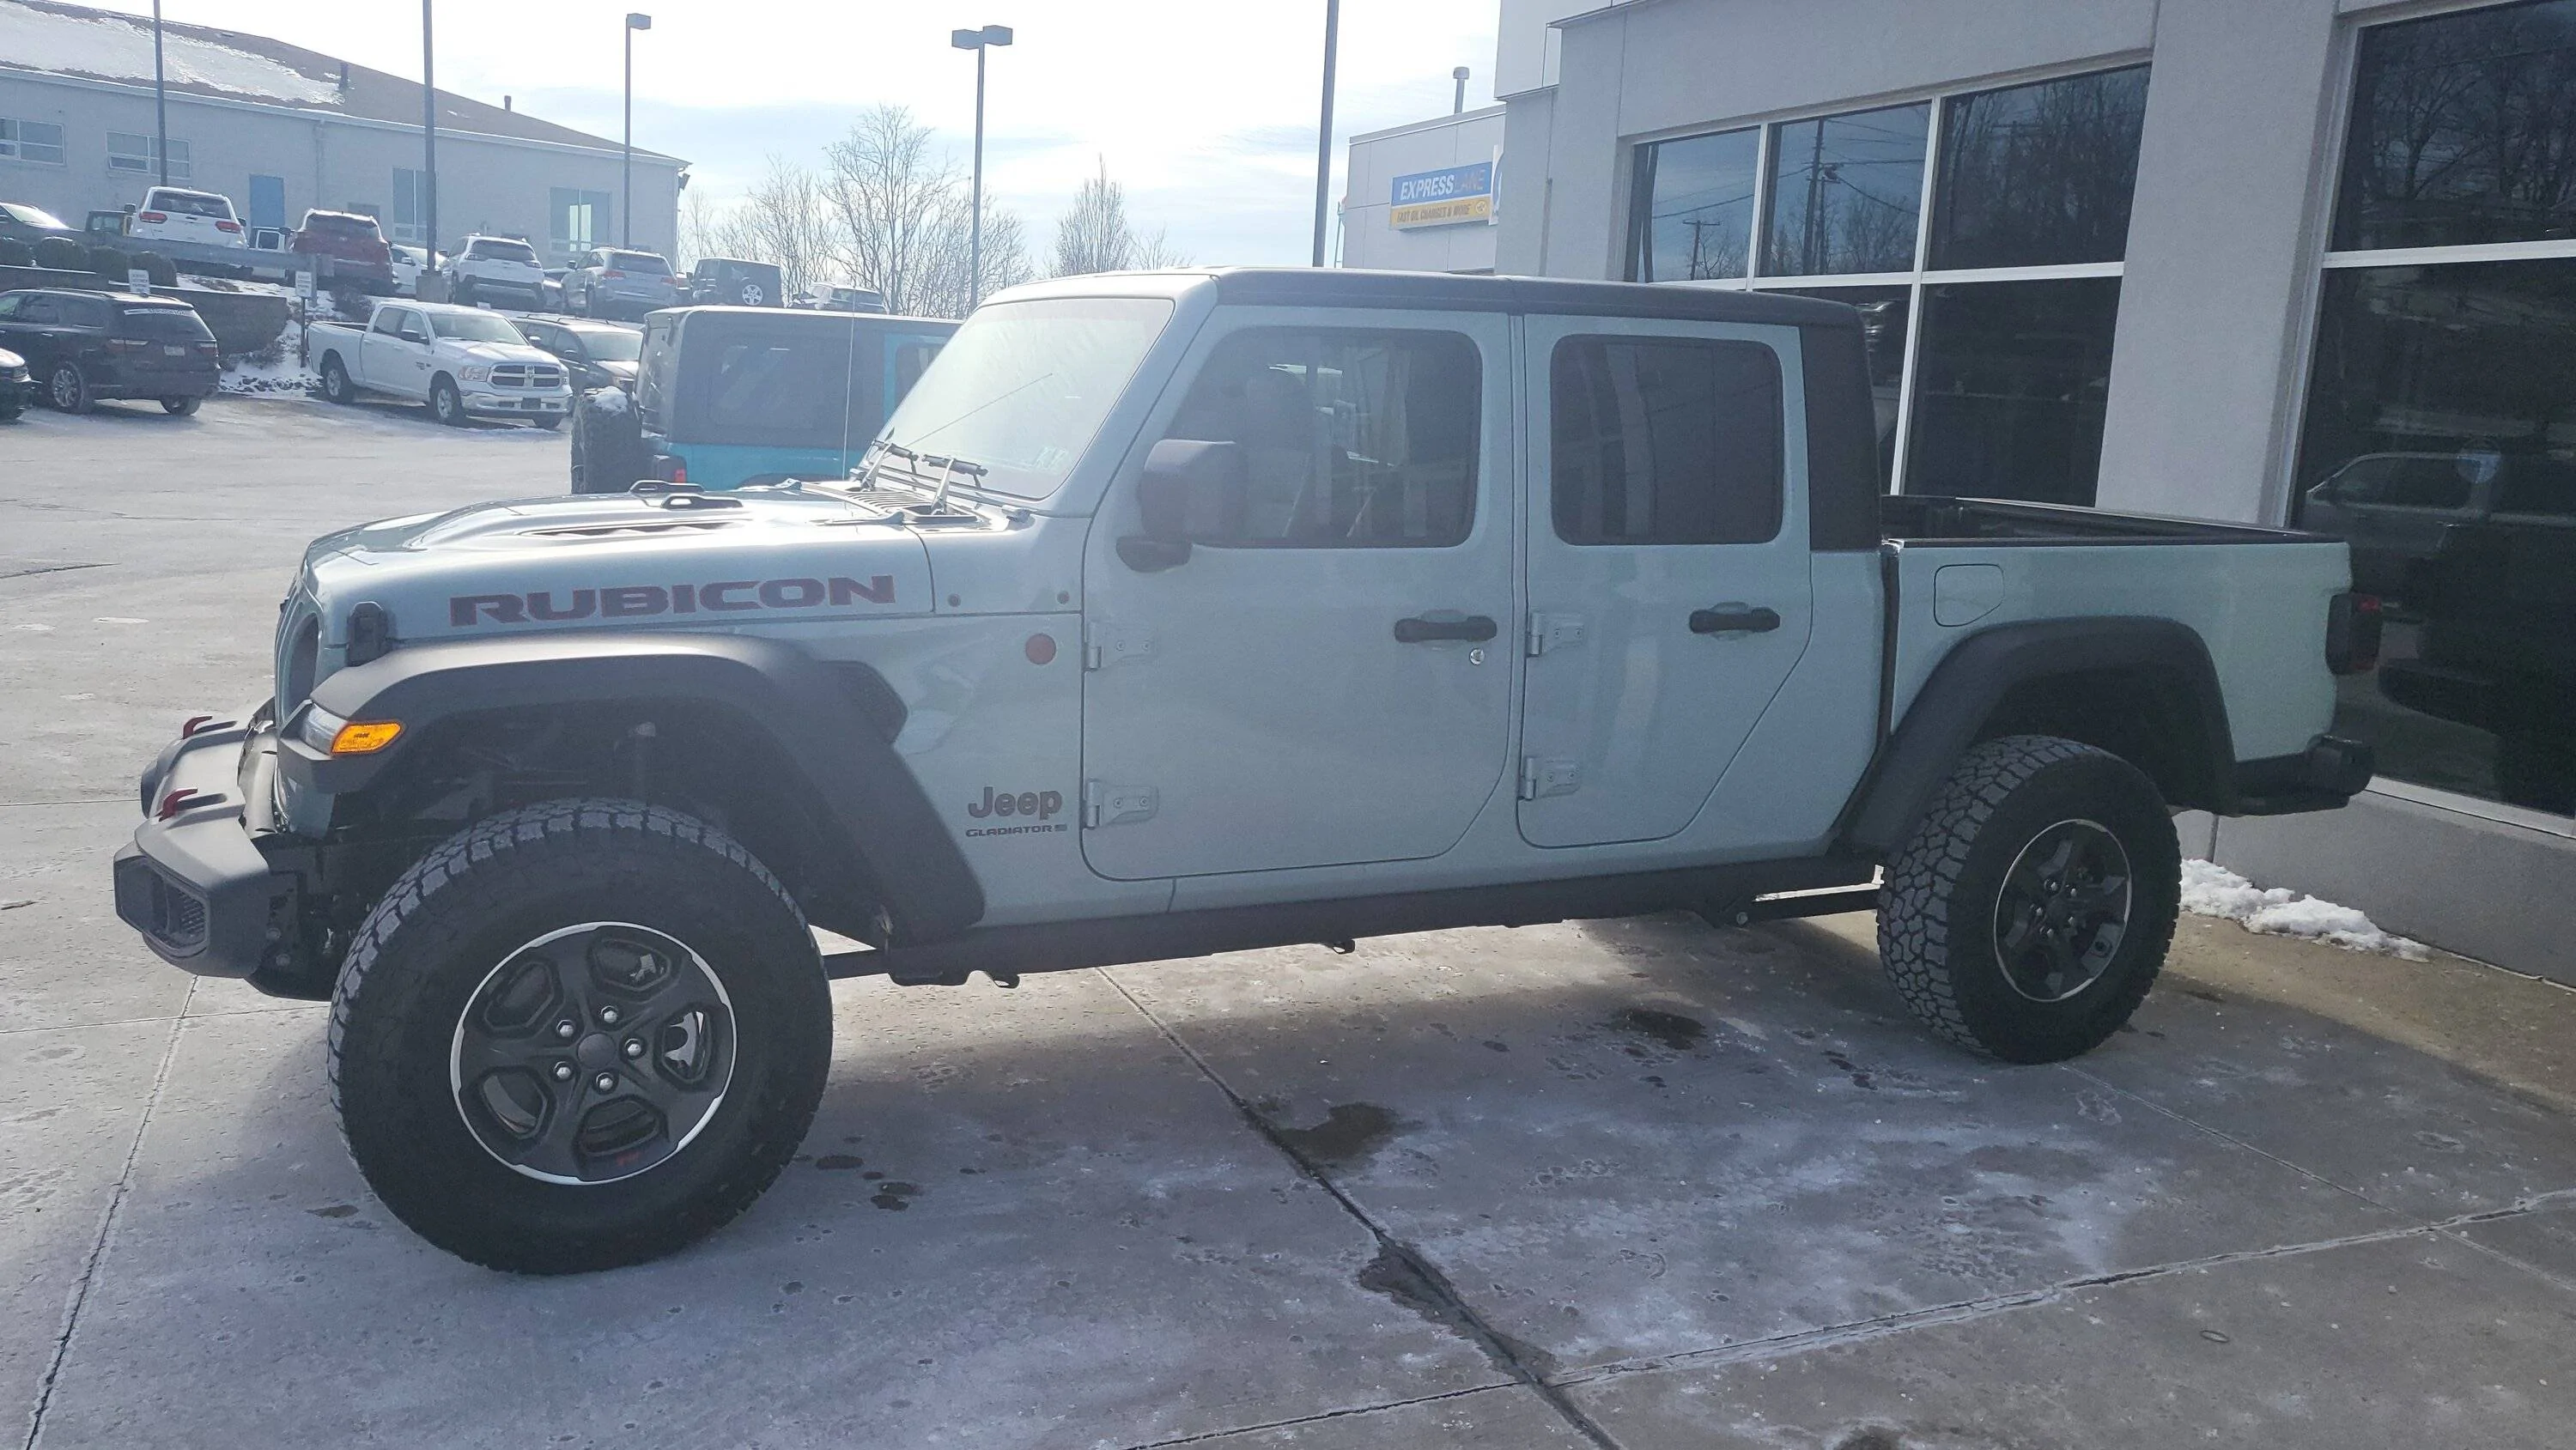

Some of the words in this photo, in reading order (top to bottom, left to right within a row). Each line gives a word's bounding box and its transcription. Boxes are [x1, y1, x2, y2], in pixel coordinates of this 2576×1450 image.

[1400, 174, 1455, 200] EXPRESS
[450, 574, 896, 627] RUBICON
[968, 786, 1062, 821] Jeep
[965, 825, 1052, 837] GLADIATOR
